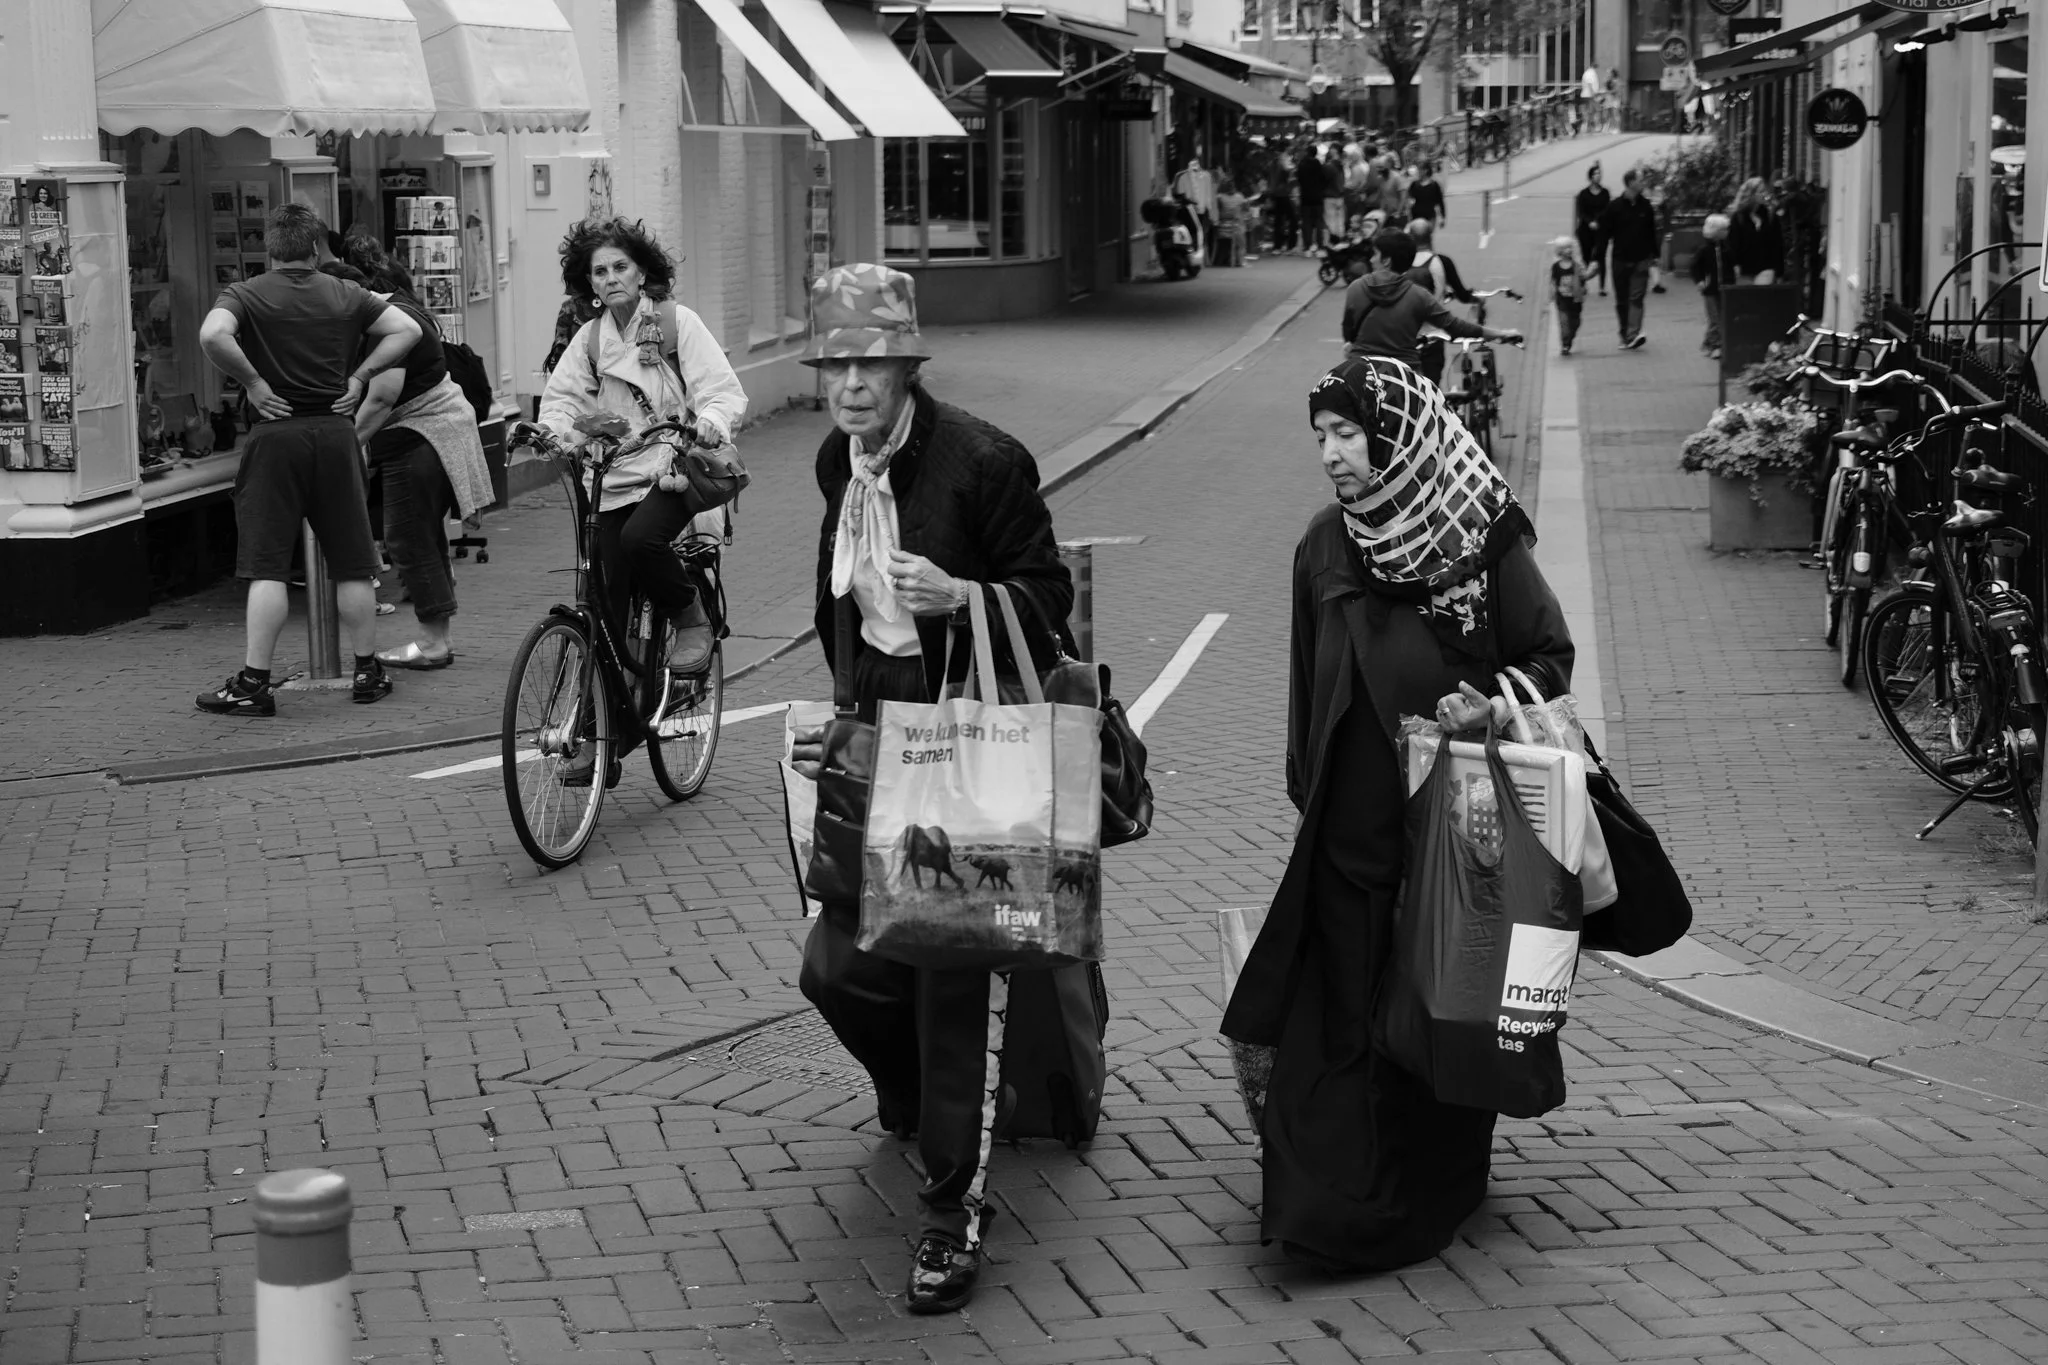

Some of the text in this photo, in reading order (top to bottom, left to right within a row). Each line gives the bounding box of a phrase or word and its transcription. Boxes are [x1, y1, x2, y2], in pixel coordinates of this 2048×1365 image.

[42, 393, 71, 403] CATS
[935, 722, 986, 742] kunen
[991, 722, 1030, 743] het
[901, 747, 953, 765] samen
[995, 904, 1042, 926] ifaw
[1506, 983, 1568, 1012] marqt
[1497, 1035, 1525, 1053] tas
